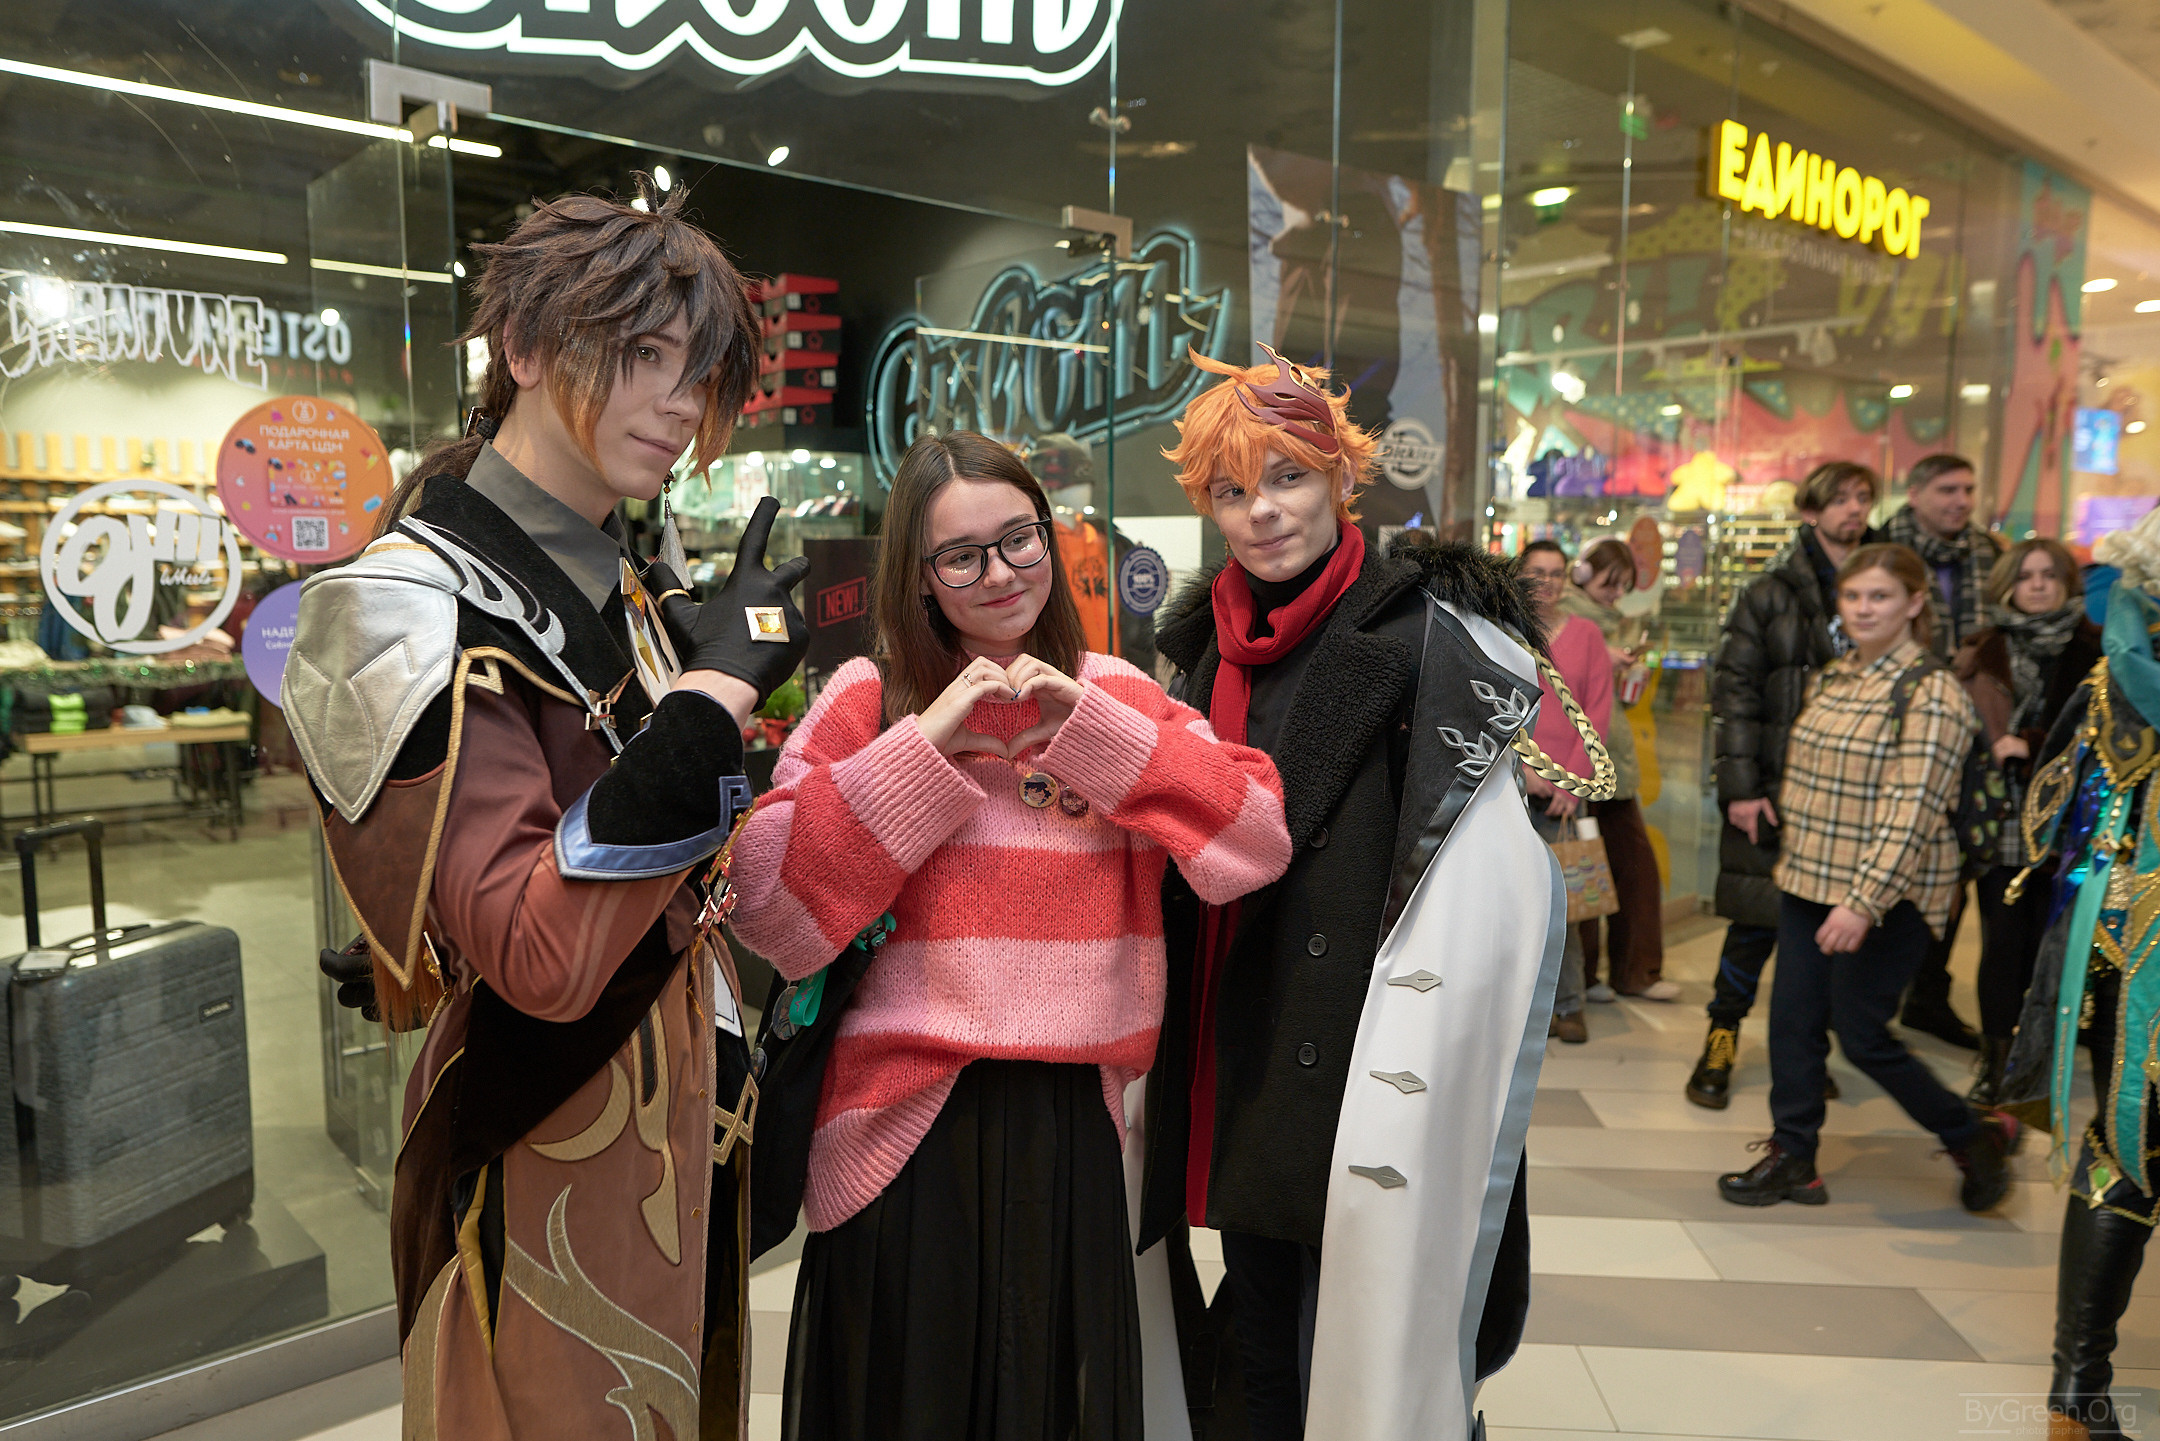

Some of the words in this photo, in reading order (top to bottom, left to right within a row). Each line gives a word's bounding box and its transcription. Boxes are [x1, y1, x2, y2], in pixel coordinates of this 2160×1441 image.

[1716, 118, 1931, 261] ЕДИНОРОГ
[259, 424, 350, 440] ПОДАРОЧНАЯ
[268, 438, 310, 451] КАРТА
[312, 441, 344, 454] ЦДМ
[825, 583, 859, 619] NEW!
[261, 627, 296, 639] НАДЕ
